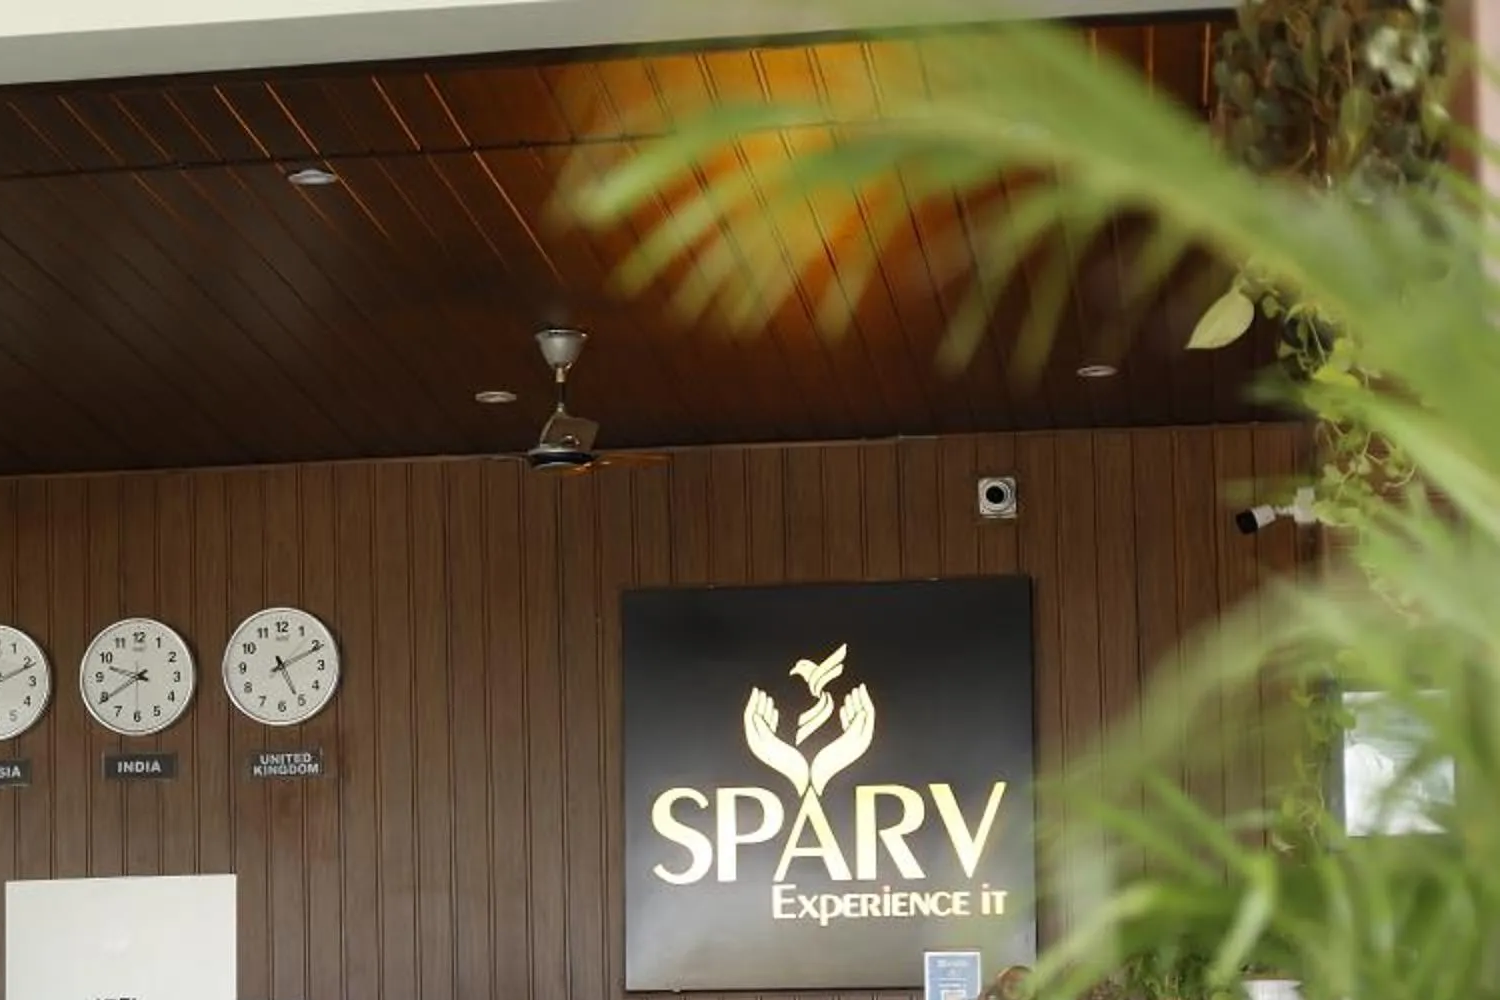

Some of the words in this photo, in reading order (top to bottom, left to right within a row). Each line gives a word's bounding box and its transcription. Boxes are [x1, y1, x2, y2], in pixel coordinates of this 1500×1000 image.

[276, 621, 288, 632] 12
[299, 626, 304, 636] 1
[133, 632, 145, 642] 12
[258, 627, 268, 638] 11
[115, 638, 125, 648] 11
[156, 637, 161, 648] 1
[243, 642, 256, 654] 10
[11, 643, 16, 654] 1
[100, 652, 112, 663] 10
[169, 652, 176, 662] 2
[239, 662, 246, 674] 9
[318, 660, 324, 670] 3
[29, 676, 36, 687] 3
[96, 672, 104, 682] 9
[174, 671, 180, 682] 3
[244, 682, 252, 693] 8
[312, 680, 319, 690] 4
[24, 696, 31, 706] 4
[168, 690, 175, 701] 4
[259, 696, 266, 705] 7
[114, 706, 122, 716] 7
[154, 706, 160, 716] 5
[278, 701, 286, 712] 6
[10, 710, 17, 721] 5
[134, 711, 141, 722] 6
[260, 753, 311, 764] UNITED
[117, 760, 161, 774] INDIA
[253, 764, 319, 776] KINGDOM
[651, 782, 1006, 884] SPARV
